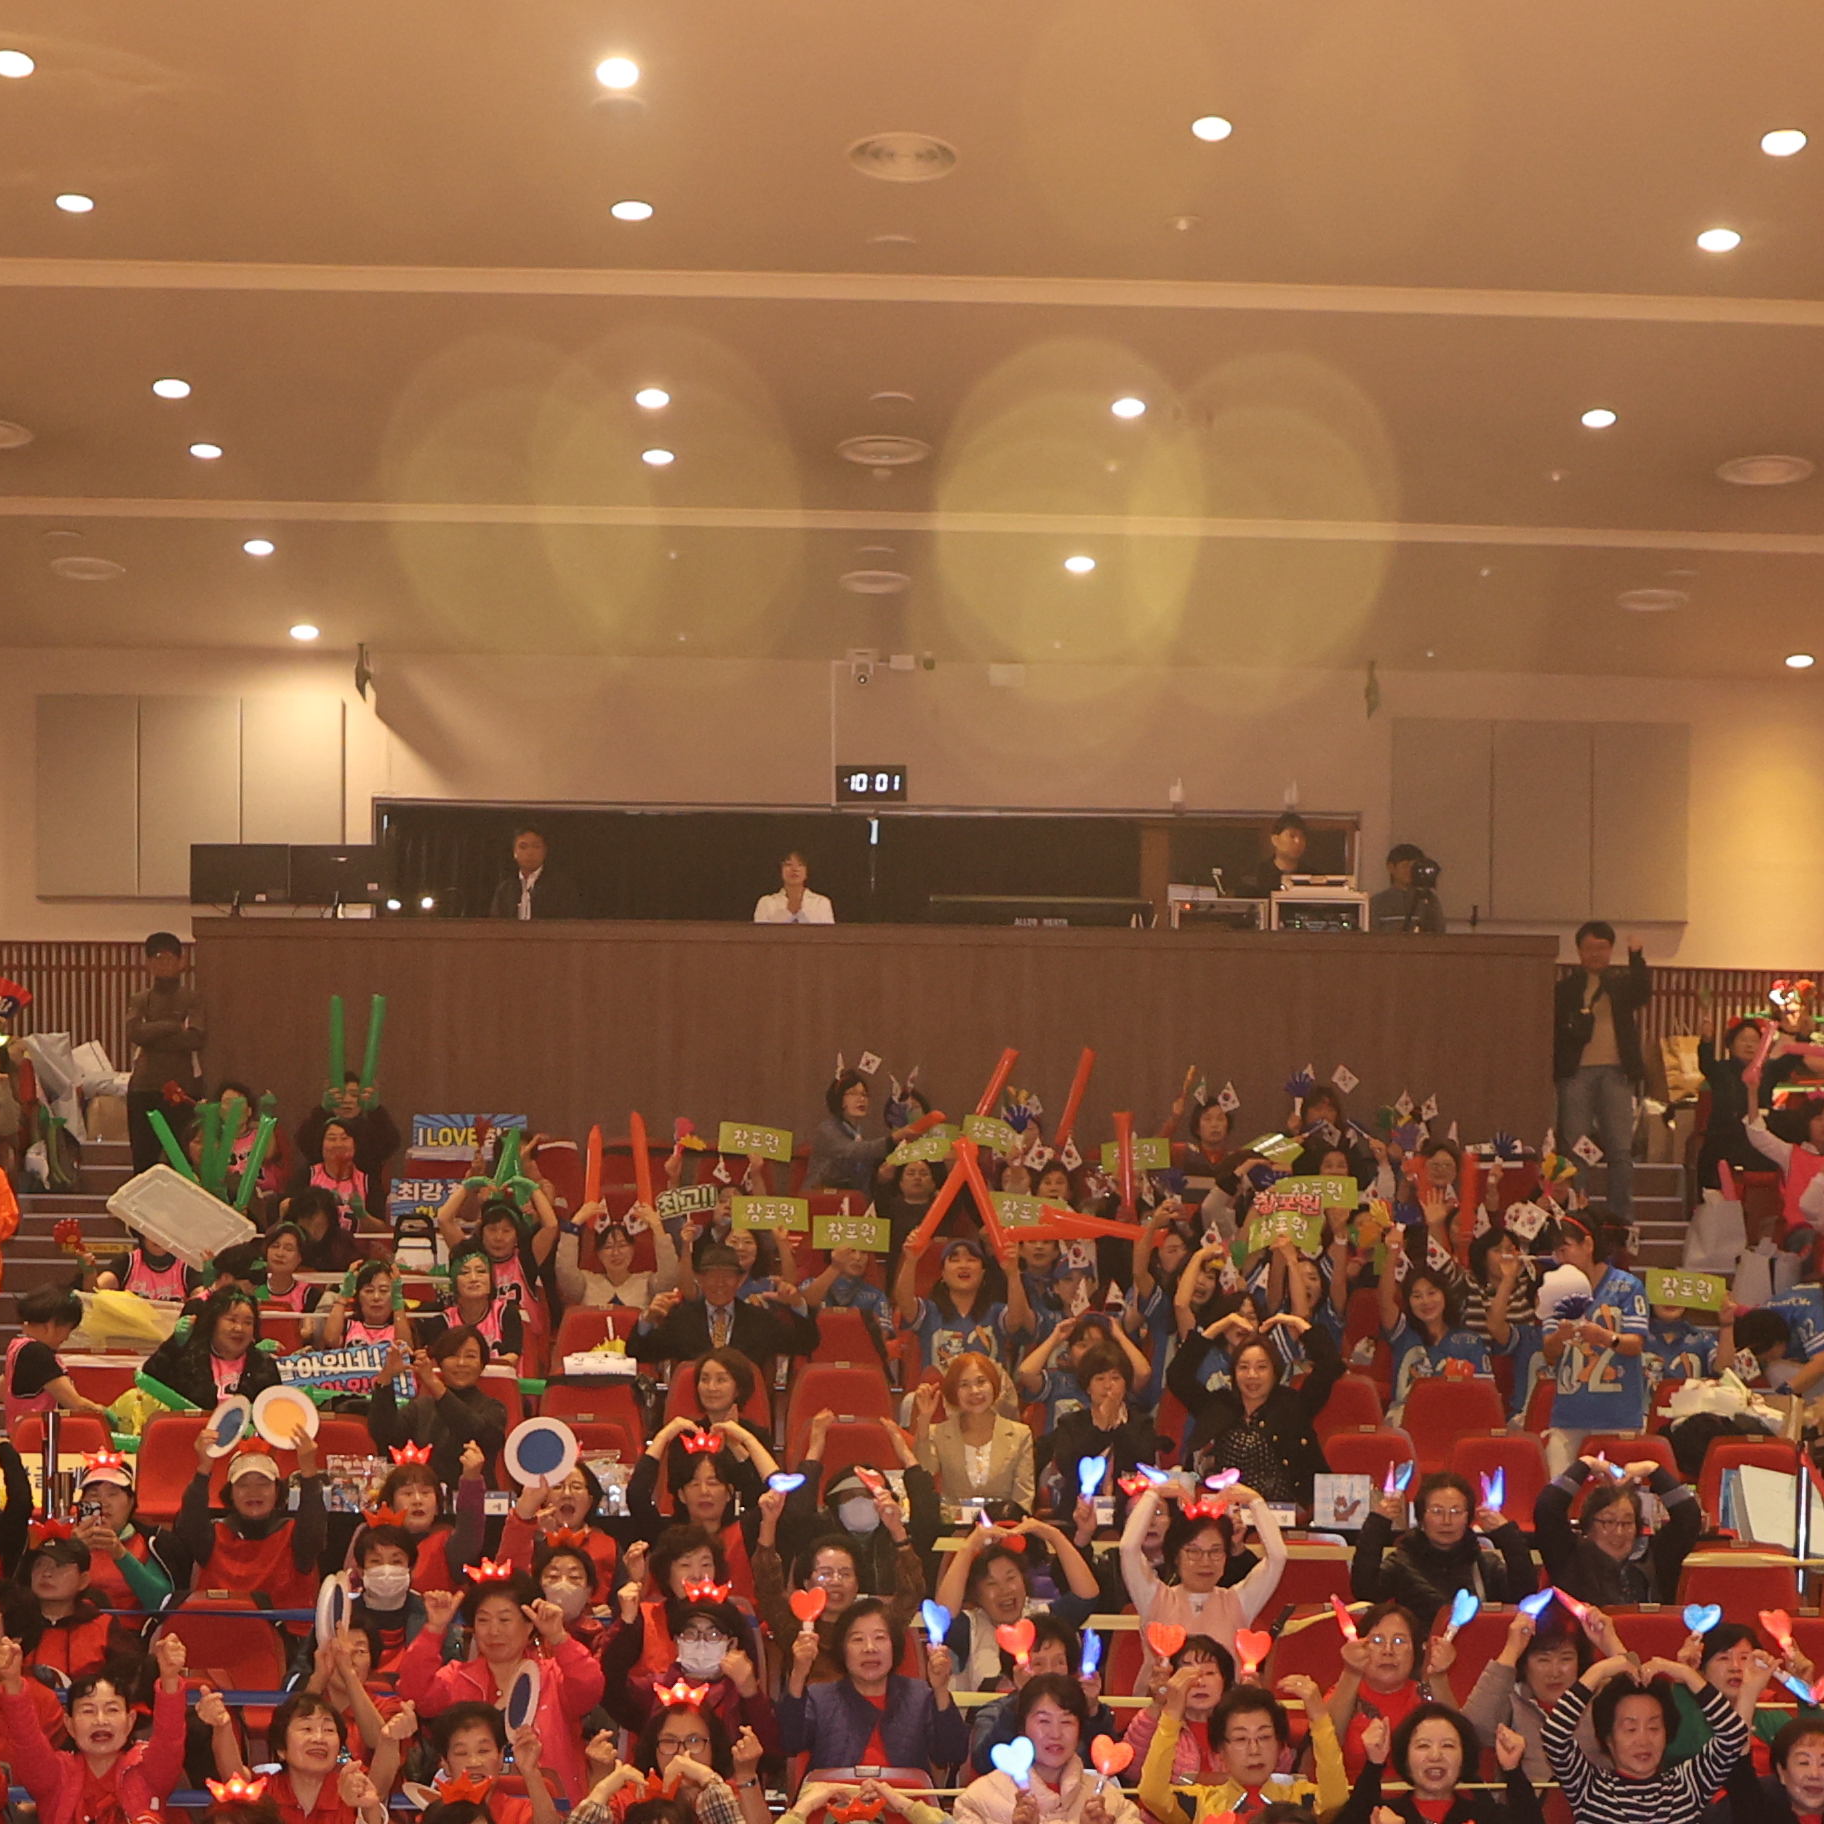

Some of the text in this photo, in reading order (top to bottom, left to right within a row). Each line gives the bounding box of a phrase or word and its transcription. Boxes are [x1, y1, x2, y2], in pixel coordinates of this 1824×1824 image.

[850, 772, 901, 793] 10:01
[426, 1126, 477, 1147] LOVE
[396, 1181, 440, 1202] 최강
[657, 1185, 717, 1216] 최고!!
[1002, 1200, 1040, 1221] 창포
